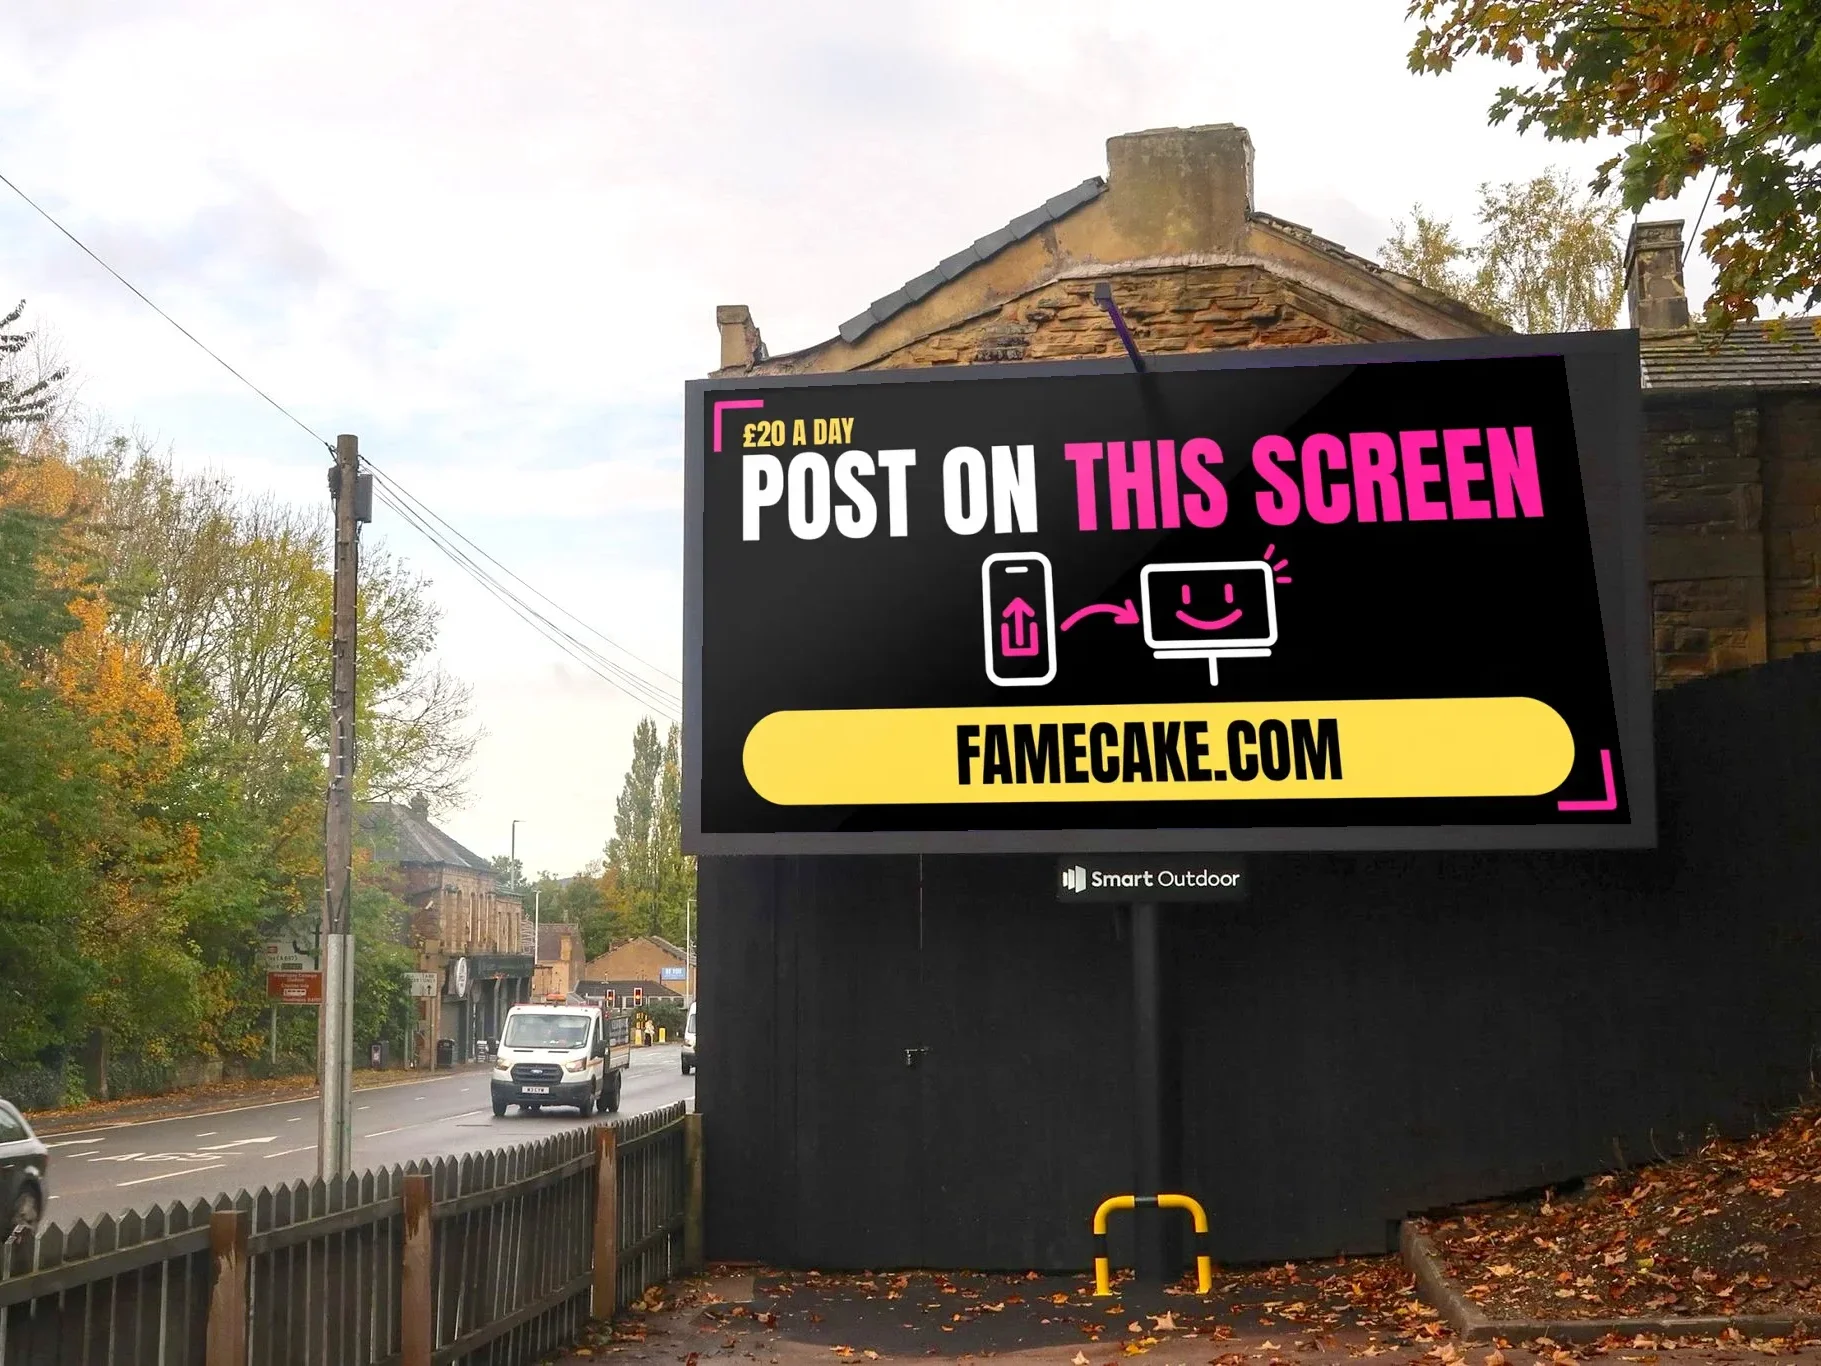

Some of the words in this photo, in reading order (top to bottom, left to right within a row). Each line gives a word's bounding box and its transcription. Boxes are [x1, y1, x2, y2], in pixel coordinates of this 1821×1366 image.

[743, 420, 785, 447] £20
[793, 419, 806, 445] A
[814, 418, 854, 445] DAY
[743, 449, 916, 541] POST
[943, 445, 1037, 535] ON
[1065, 438, 1227, 530] THIS
[1252, 427, 1543, 525] SCREEN
[957, 719, 1342, 784] FAMECAKE.COM
[1092, 871, 1153, 887] Smart
[1158, 870, 1240, 886] Outdoor
